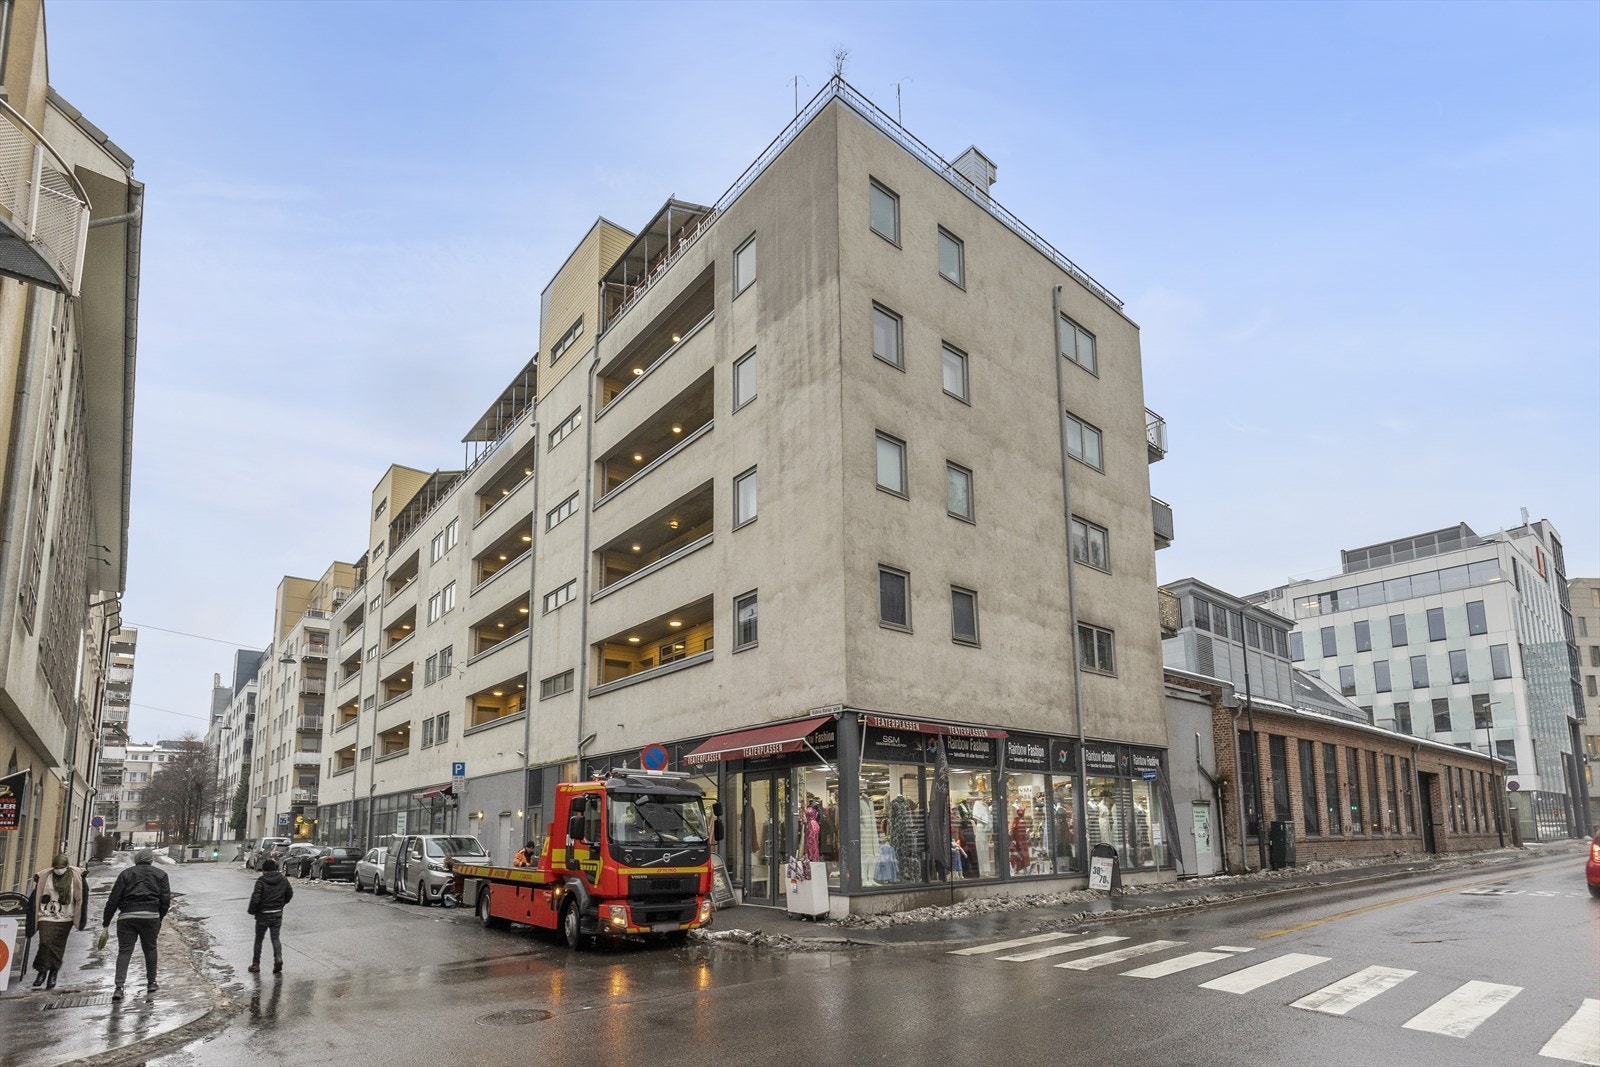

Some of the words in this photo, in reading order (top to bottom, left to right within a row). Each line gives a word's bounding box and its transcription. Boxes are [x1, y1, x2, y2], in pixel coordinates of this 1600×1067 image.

[874, 717, 920, 731] TEATERPLASSEN
[948, 726, 988, 737] TEATERPLASSEN
[947, 736, 969, 750] Rainbow
[970, 738, 989, 752] Fashion
[1008, 742, 1027, 755] Rainbow
[1027, 744, 1045, 757] Fashion
[743, 744, 783, 757] TEATERPLASSEN
[1086, 750, 1101, 761] Rainbow
[1101, 751, 1116, 762] Fashion
[687, 753, 721, 764] TEATERPLASSEN
[455, 764, 463, 775] P
